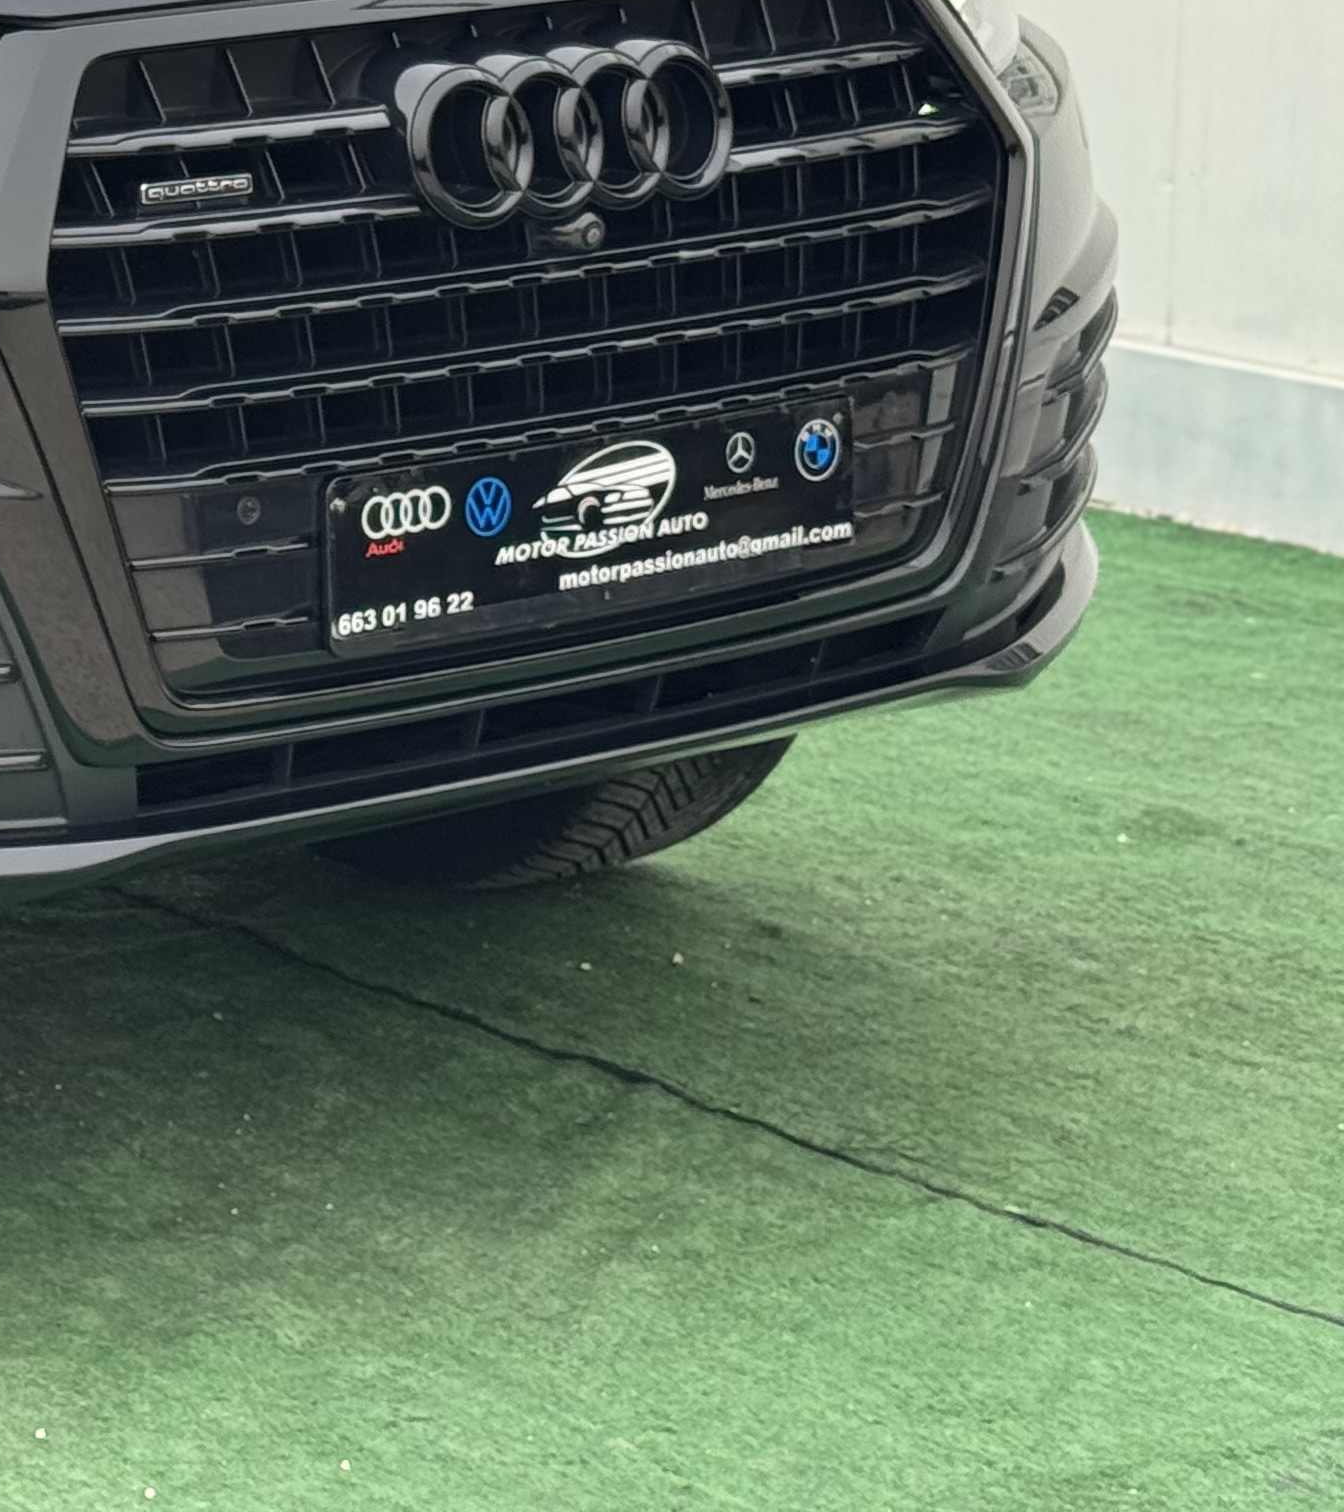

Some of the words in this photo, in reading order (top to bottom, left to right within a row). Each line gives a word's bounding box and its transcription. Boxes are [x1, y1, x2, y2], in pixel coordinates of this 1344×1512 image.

[148, 178, 249, 201] quattro
[365, 538, 405, 558] Audi
[495, 537, 570, 565] MOTOR
[574, 522, 654, 551] PASSION
[657, 512, 709, 536] AUTO
[559, 522, 853, 590] motorpassionauto@gmail.com
[338, 609, 377, 636] 663
[382, 603, 407, 626] 01
[414, 597, 441, 620] 96
[447, 591, 474, 614] 22
